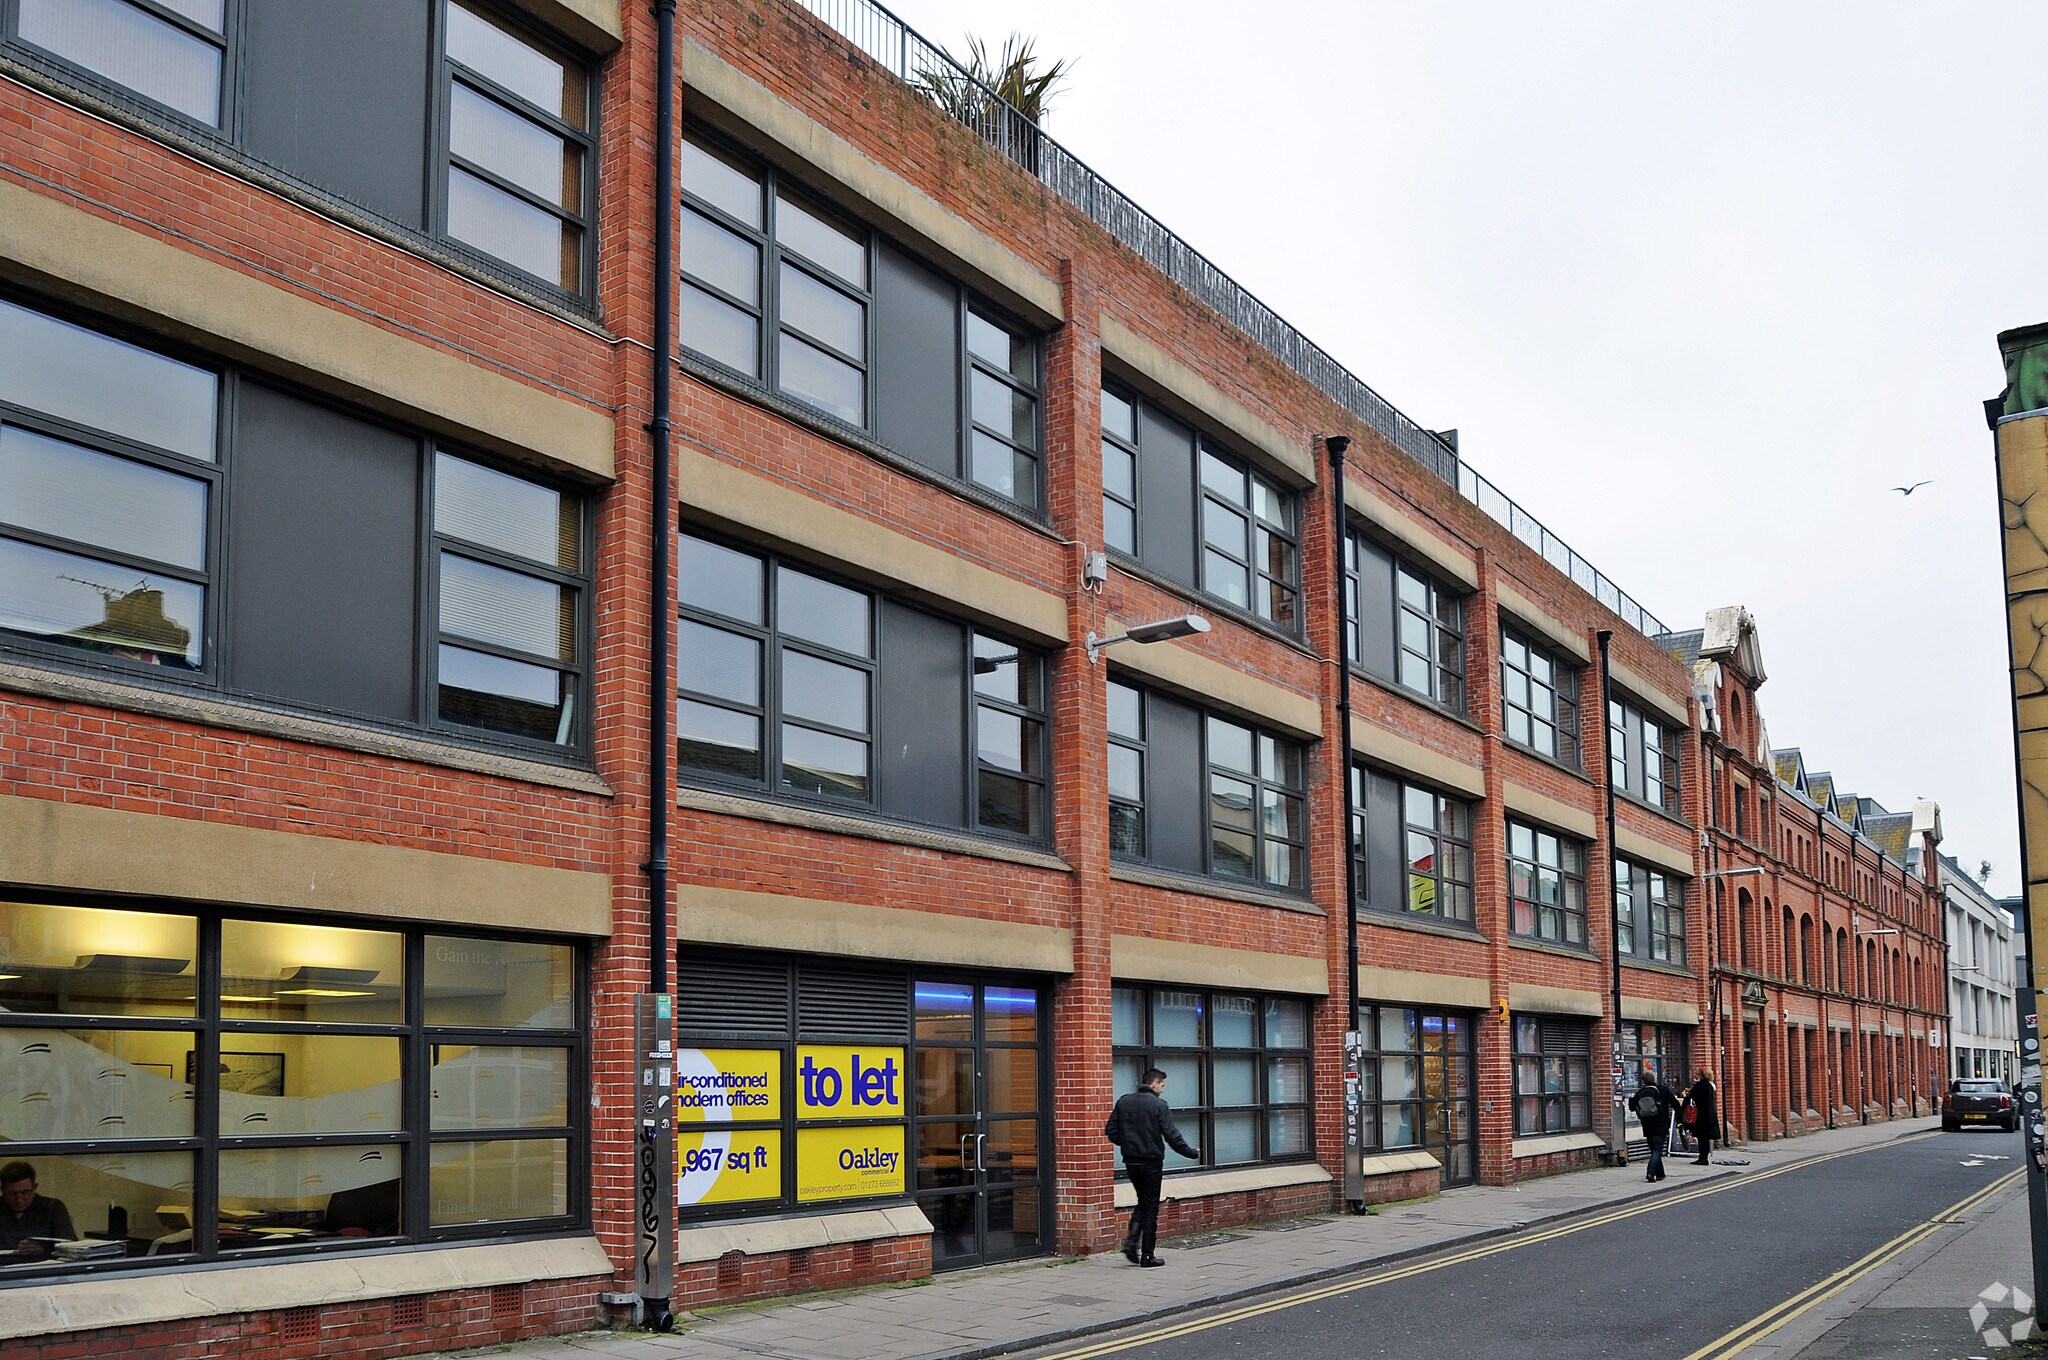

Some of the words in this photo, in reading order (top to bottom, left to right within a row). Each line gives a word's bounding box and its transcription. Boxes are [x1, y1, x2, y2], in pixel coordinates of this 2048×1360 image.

[677, 1071, 767, 1088] ir-conditioned
[800, 1056, 842, 1107] to
[851, 1054, 898, 1106] let
[726, 1090, 768, 1106] offices
[681, 1148, 723, 1178] ,967
[727, 1151, 750, 1174] sq
[753, 1145, 767, 1168] ft
[839, 1147, 899, 1173] Oakley
[861, 1168, 889, 1176] commercial
[799, 1183, 857, 1195] oakleyproperty.com
[860, 1180, 878, 1190] 01273
